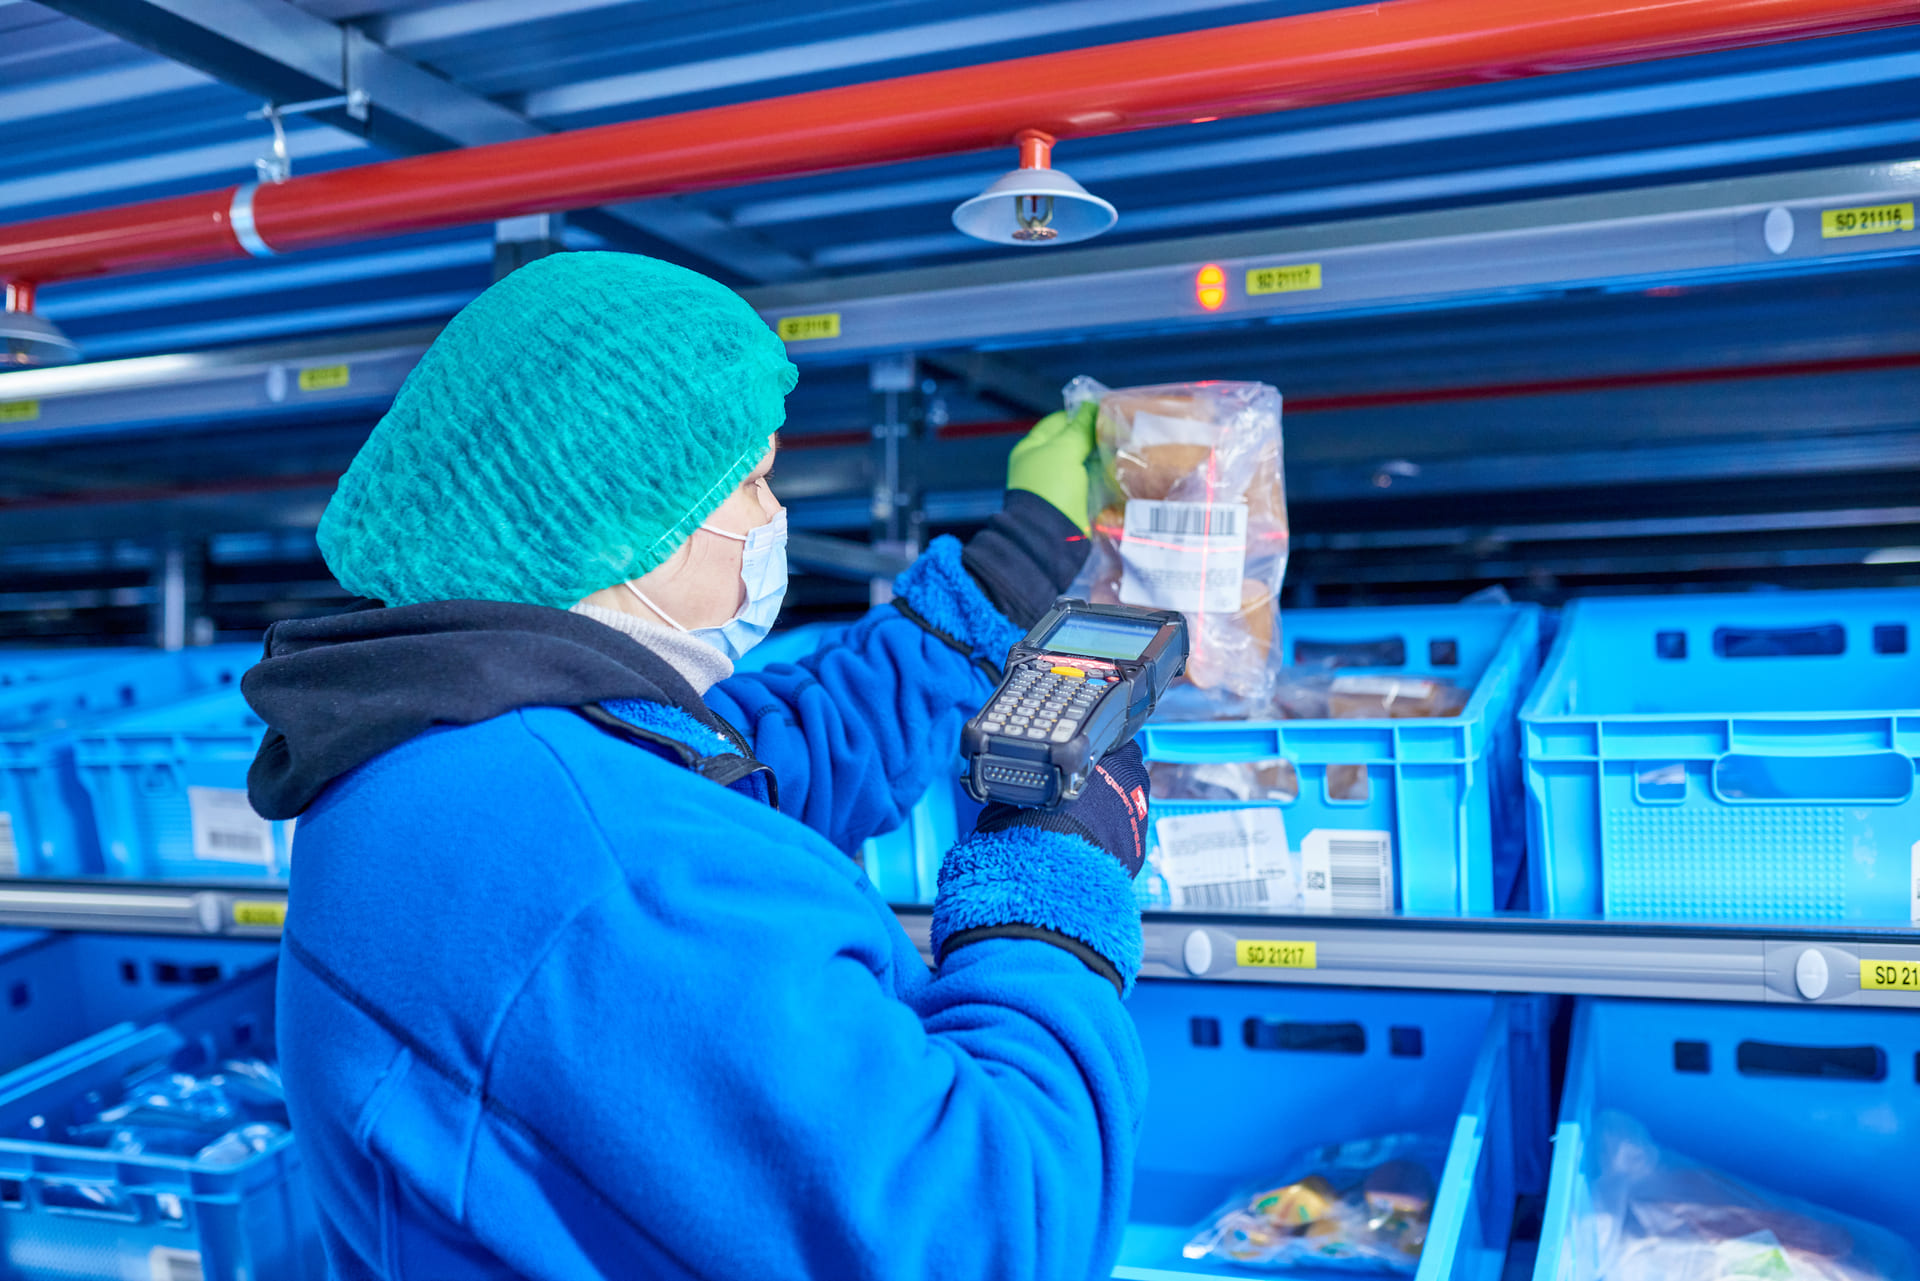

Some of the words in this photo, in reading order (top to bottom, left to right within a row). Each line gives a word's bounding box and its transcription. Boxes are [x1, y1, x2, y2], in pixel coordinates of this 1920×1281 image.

[1836, 212, 1857, 231] SD
[1247, 946, 1266, 964] SD
[1268, 947, 1305, 965] 21217
[1875, 965, 1898, 985] SD
